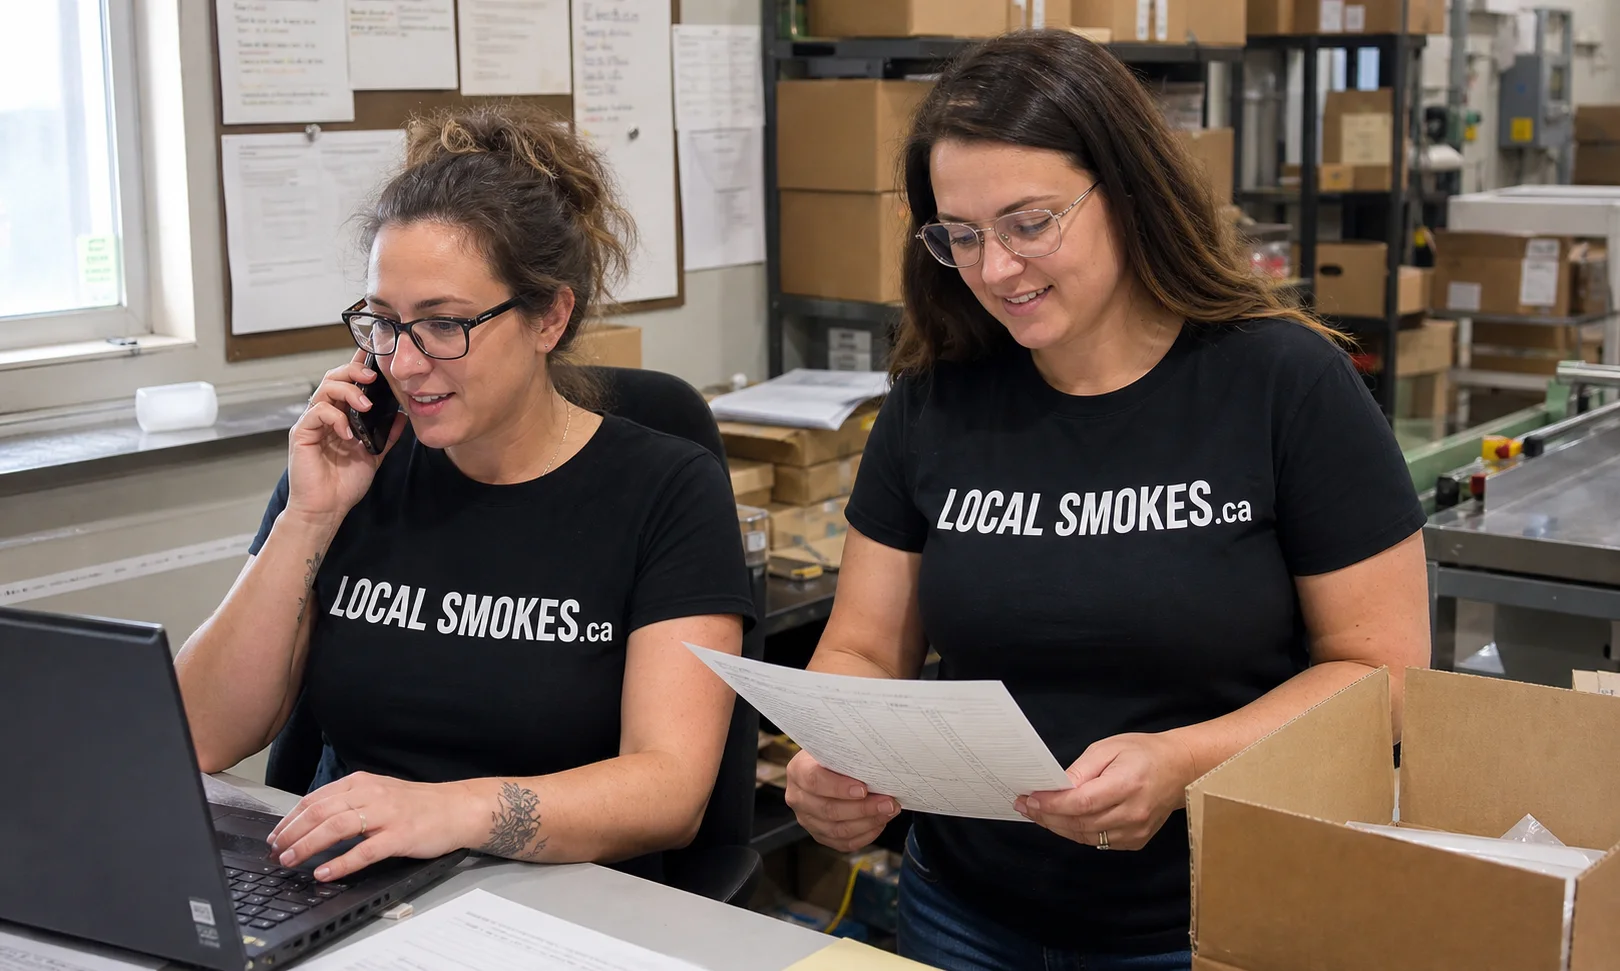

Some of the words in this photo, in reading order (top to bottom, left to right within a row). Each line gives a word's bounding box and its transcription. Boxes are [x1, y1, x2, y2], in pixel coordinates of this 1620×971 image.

[937, 489, 1043, 536] LOCAL
[1055, 480, 1252, 536] SMOKES.ca
[330, 576, 426, 631] LOCAL
[437, 592, 612, 642] SMOKES.ca
